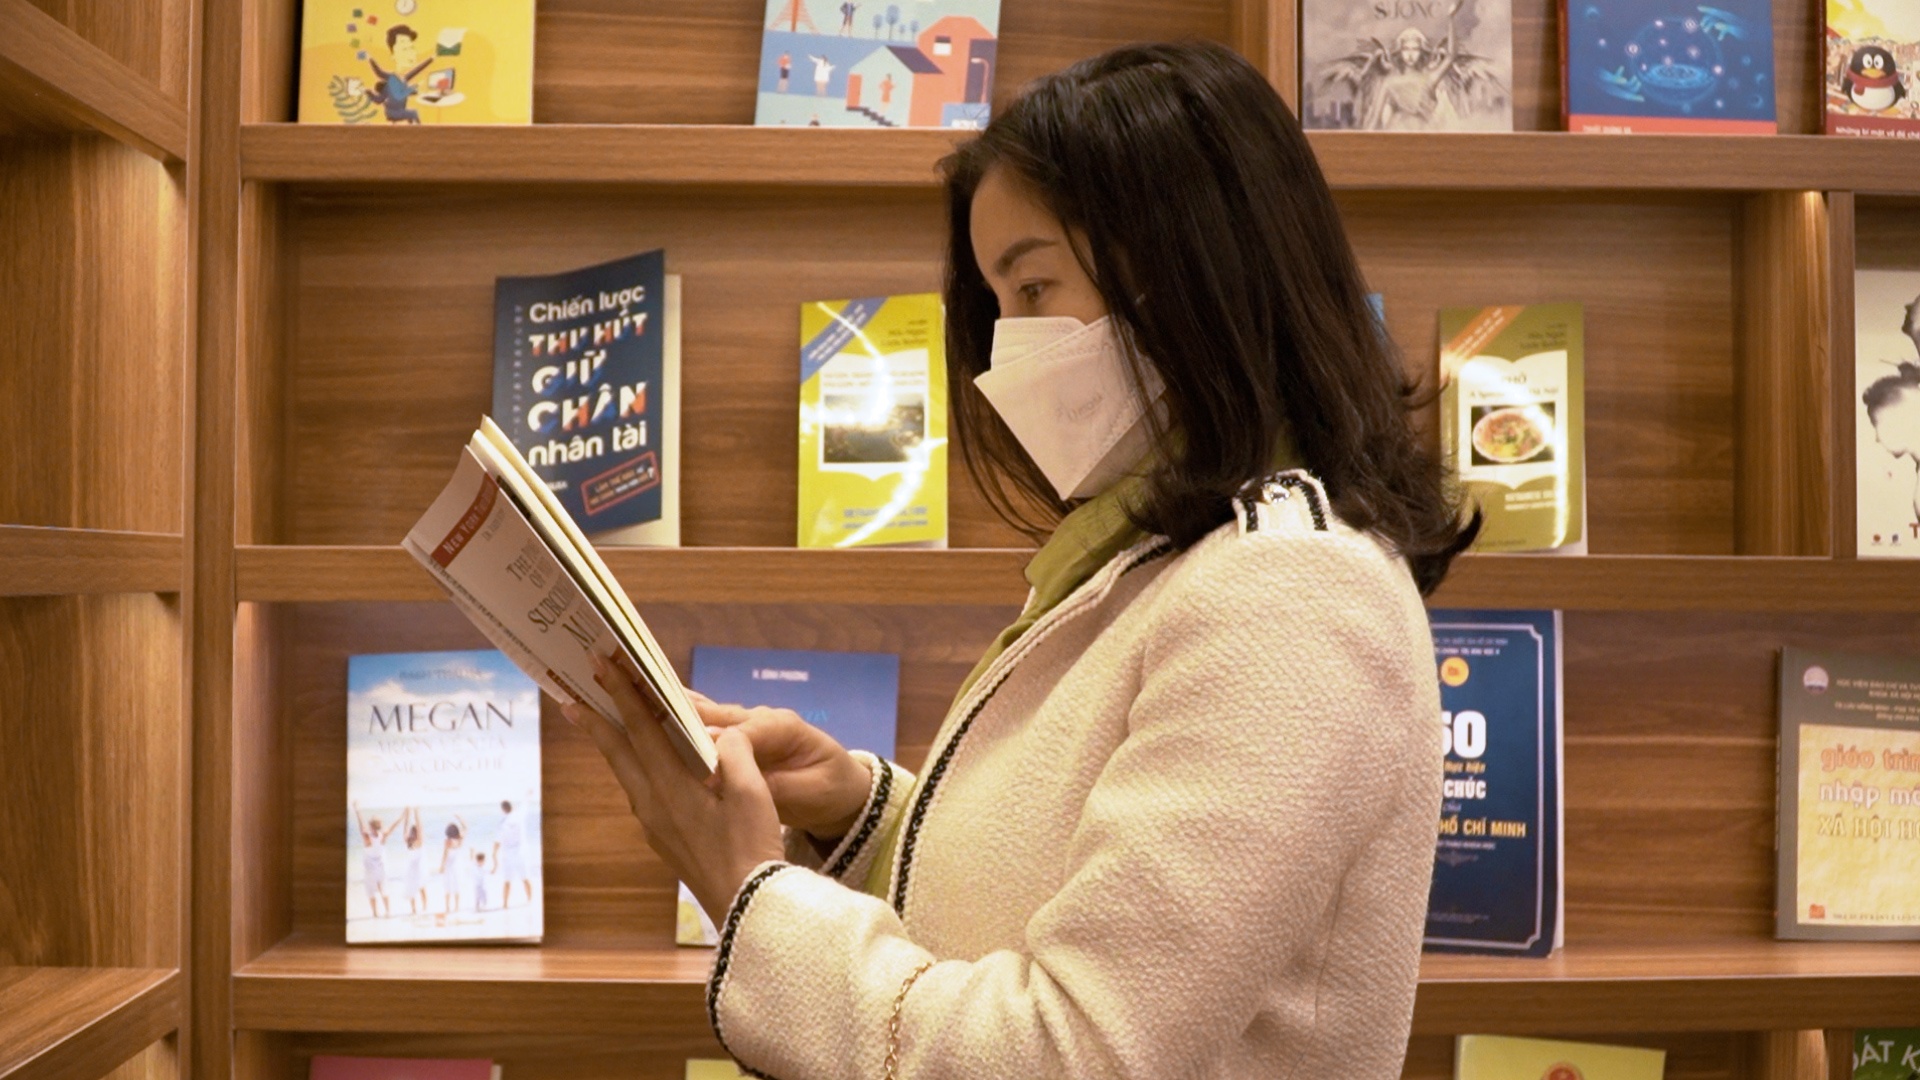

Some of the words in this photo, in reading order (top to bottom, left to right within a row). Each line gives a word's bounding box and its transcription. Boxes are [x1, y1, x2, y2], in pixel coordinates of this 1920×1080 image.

[529, 295, 594, 324] Chiến
[599, 285, 646, 311] lược
[594, 308, 648, 346] HÚT
[532, 349, 607, 397] GIỮ
[527, 381, 648, 434] CHÂN
[528, 435, 603, 467] nhân
[612, 420, 647, 452] tài
[506, 554, 532, 581] THE
[369, 700, 513, 734] MEGAN
[1821, 744, 1875, 772] giáo
[1443, 776, 1487, 799] CHÚC
[1820, 780, 1880, 810] nhập
[1490, 820, 1527, 838] MINH
[1854, 814, 1891, 843] HỘI
